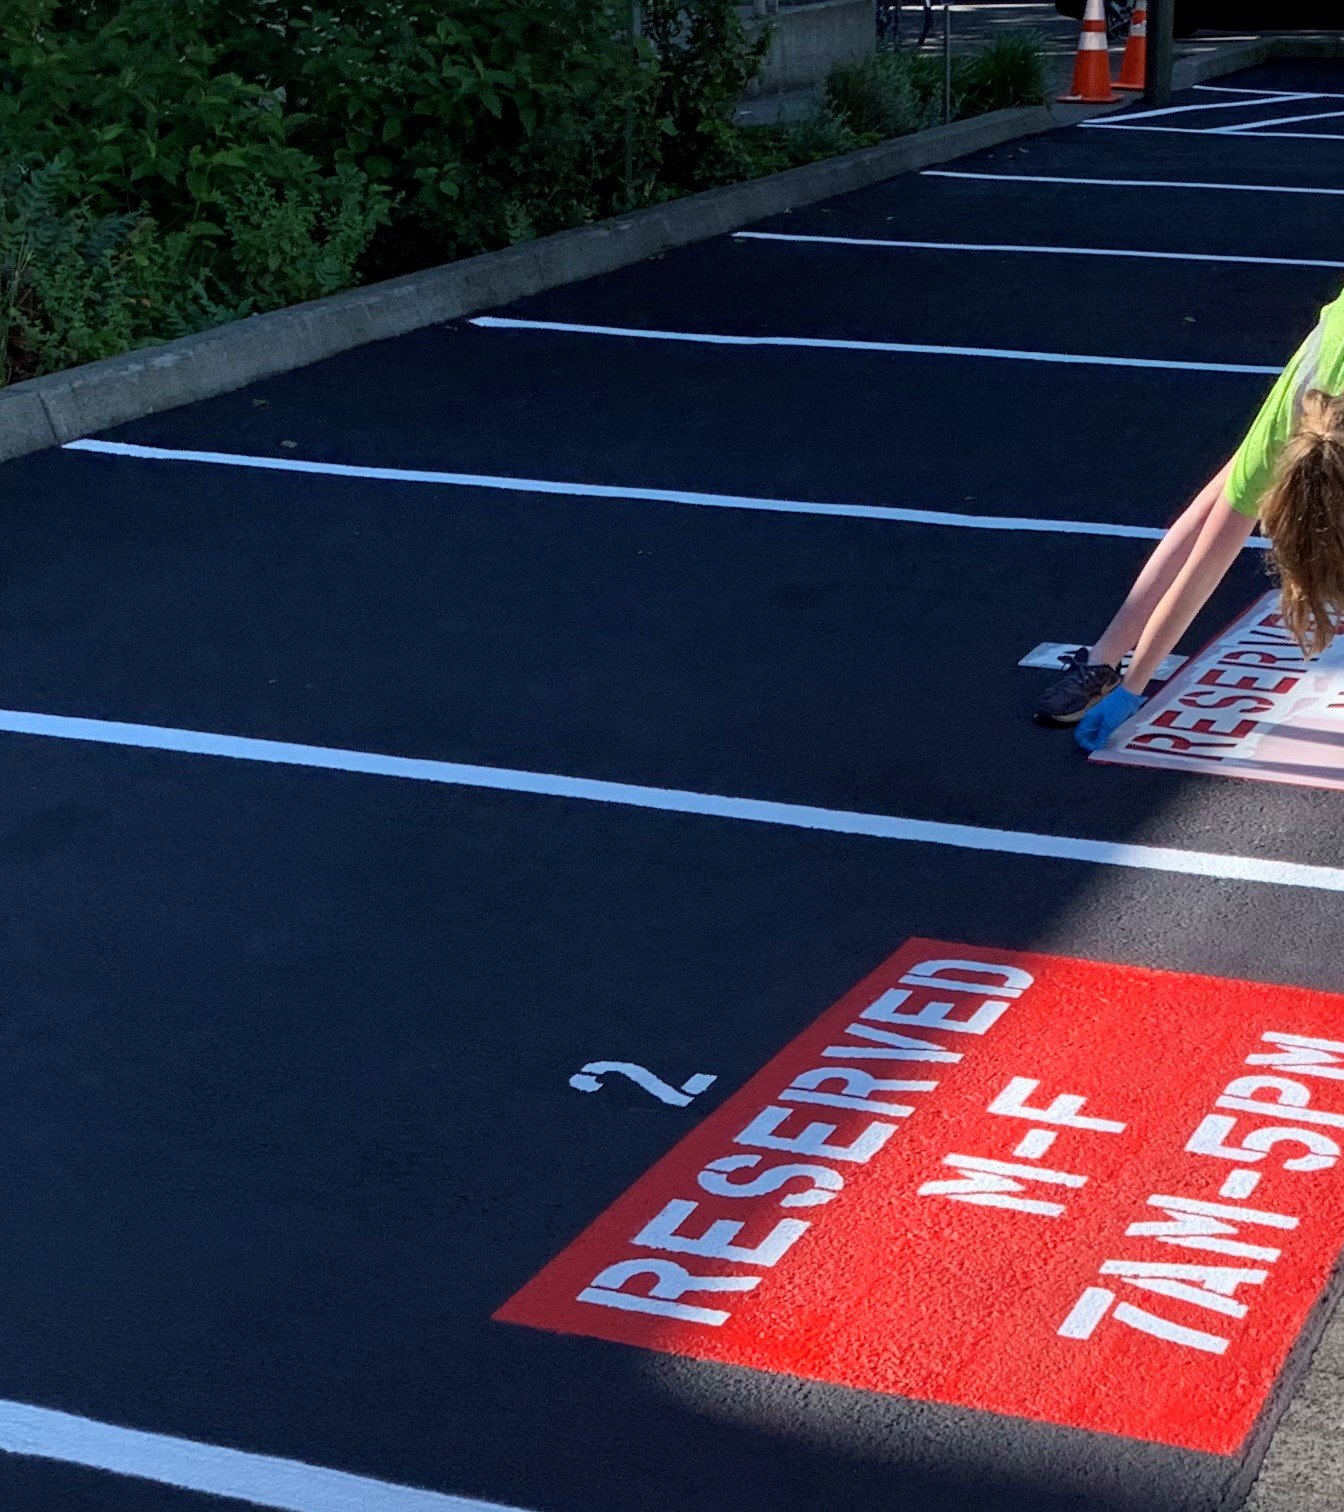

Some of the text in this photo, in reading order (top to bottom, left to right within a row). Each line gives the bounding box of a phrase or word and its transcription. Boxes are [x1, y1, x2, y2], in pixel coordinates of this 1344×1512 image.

[568, 1060, 718, 1108] 2
[575, 958, 1035, 1327] RESERVED
[917, 1077, 1126, 1217] M-F
